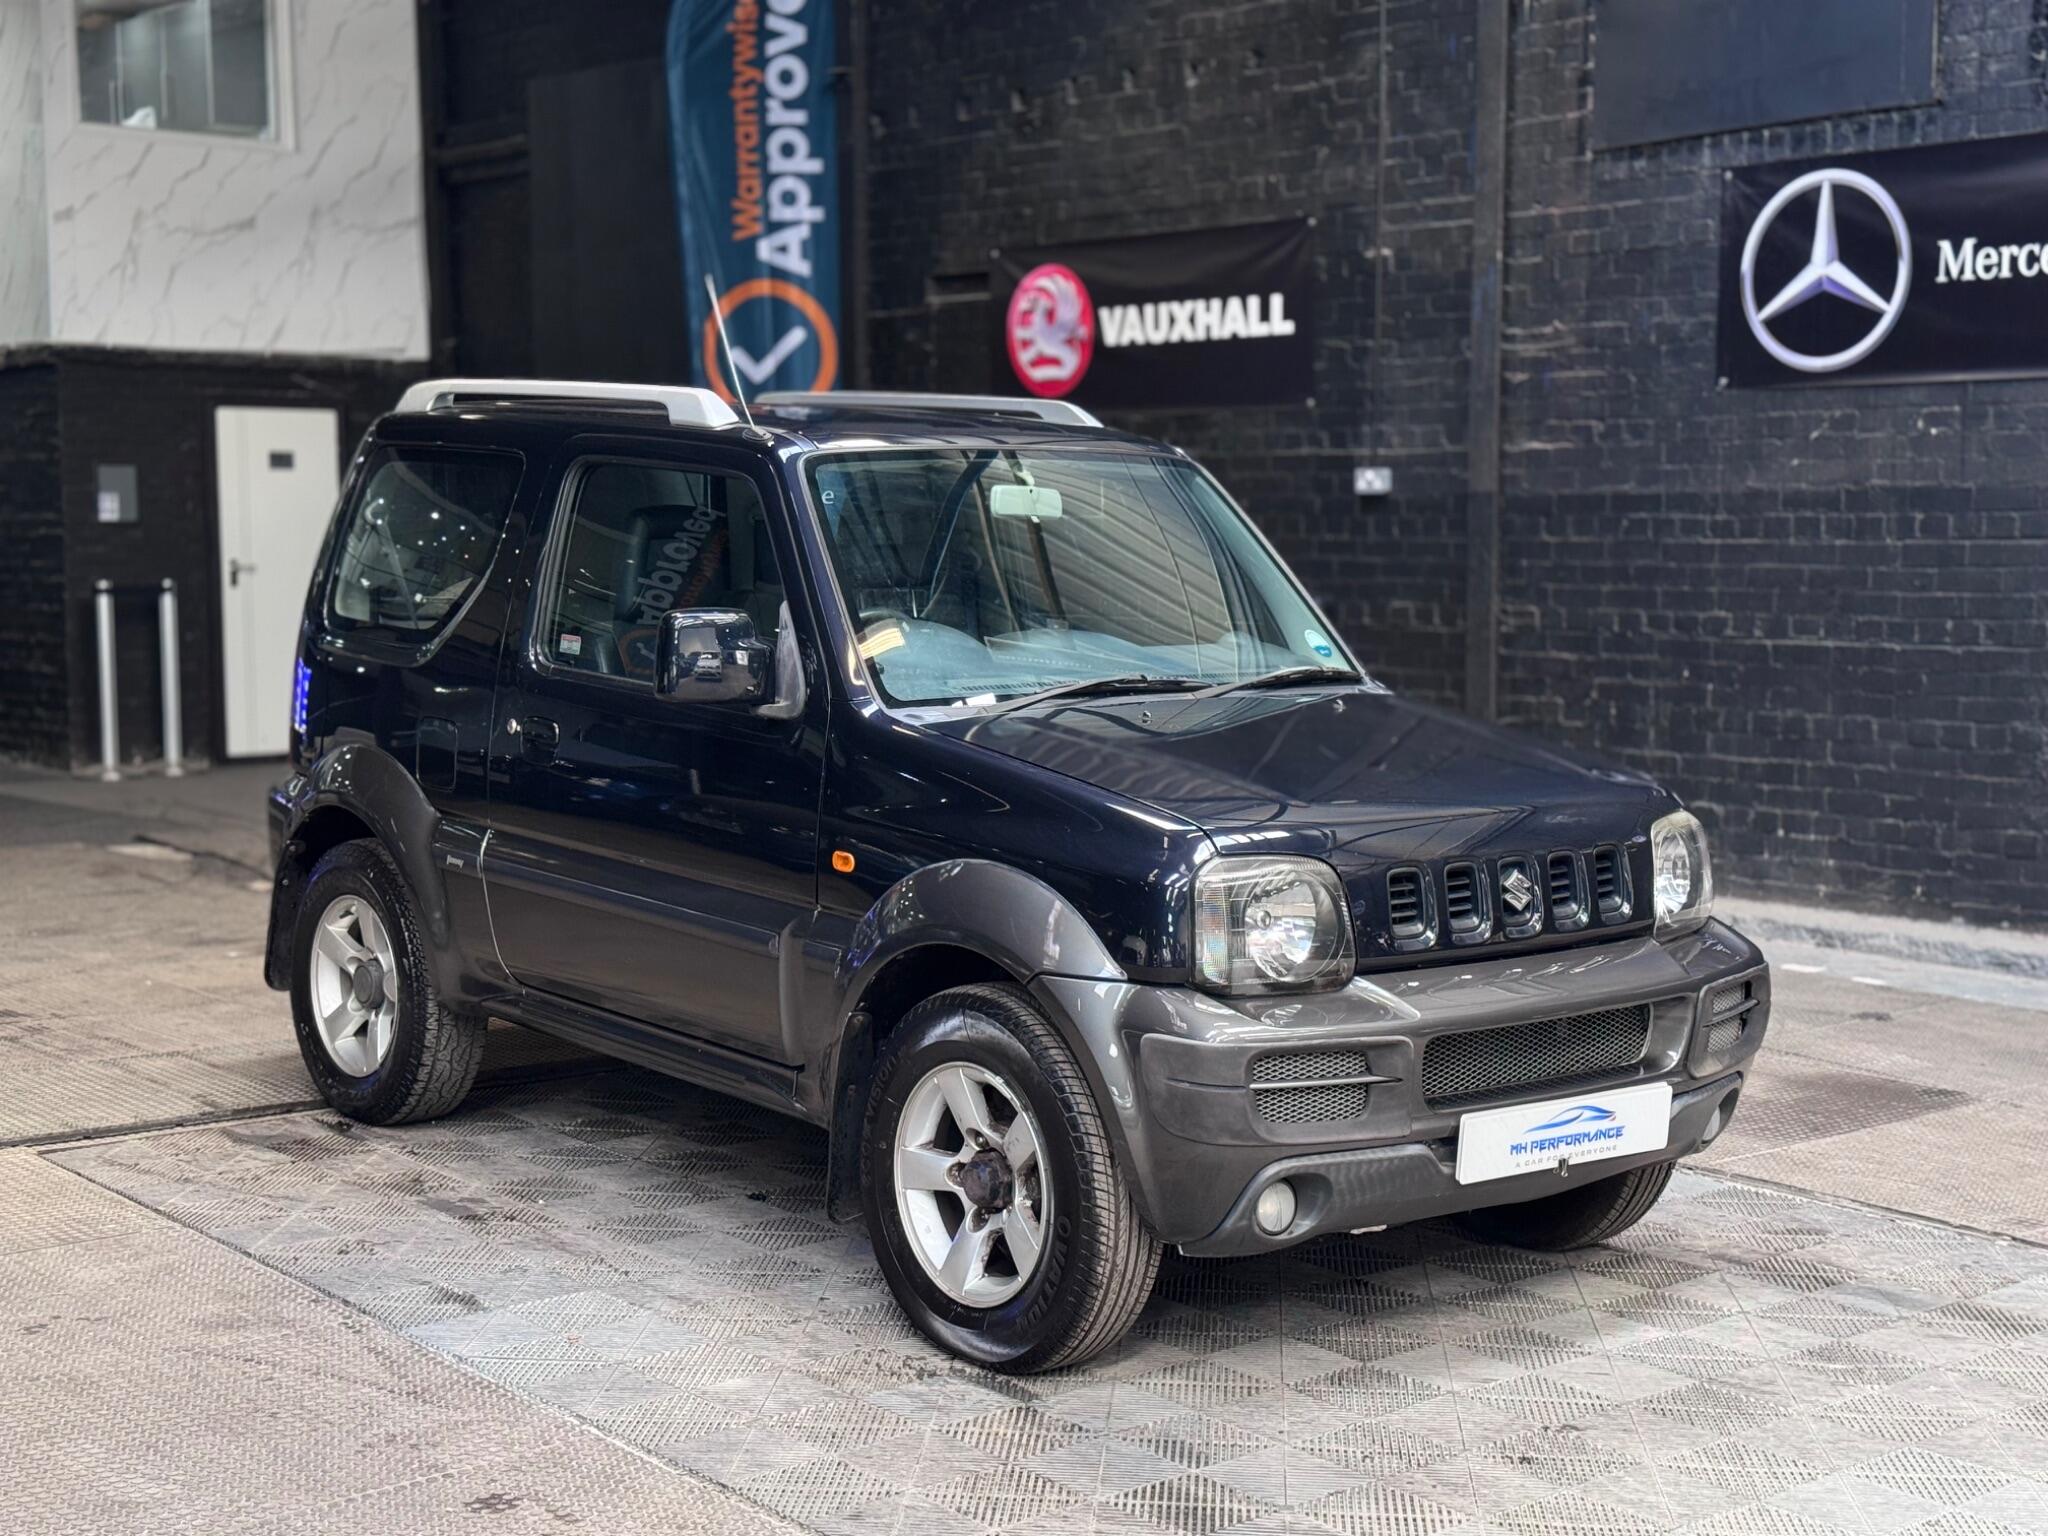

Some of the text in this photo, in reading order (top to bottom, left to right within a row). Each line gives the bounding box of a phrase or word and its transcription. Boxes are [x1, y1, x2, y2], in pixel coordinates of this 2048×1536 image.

[727, 0, 765, 241] Warrantywis
[1099, 292, 1296, 347] VAUXHALL
[1510, 1125, 1626, 1156] MH PERFORMANCE
